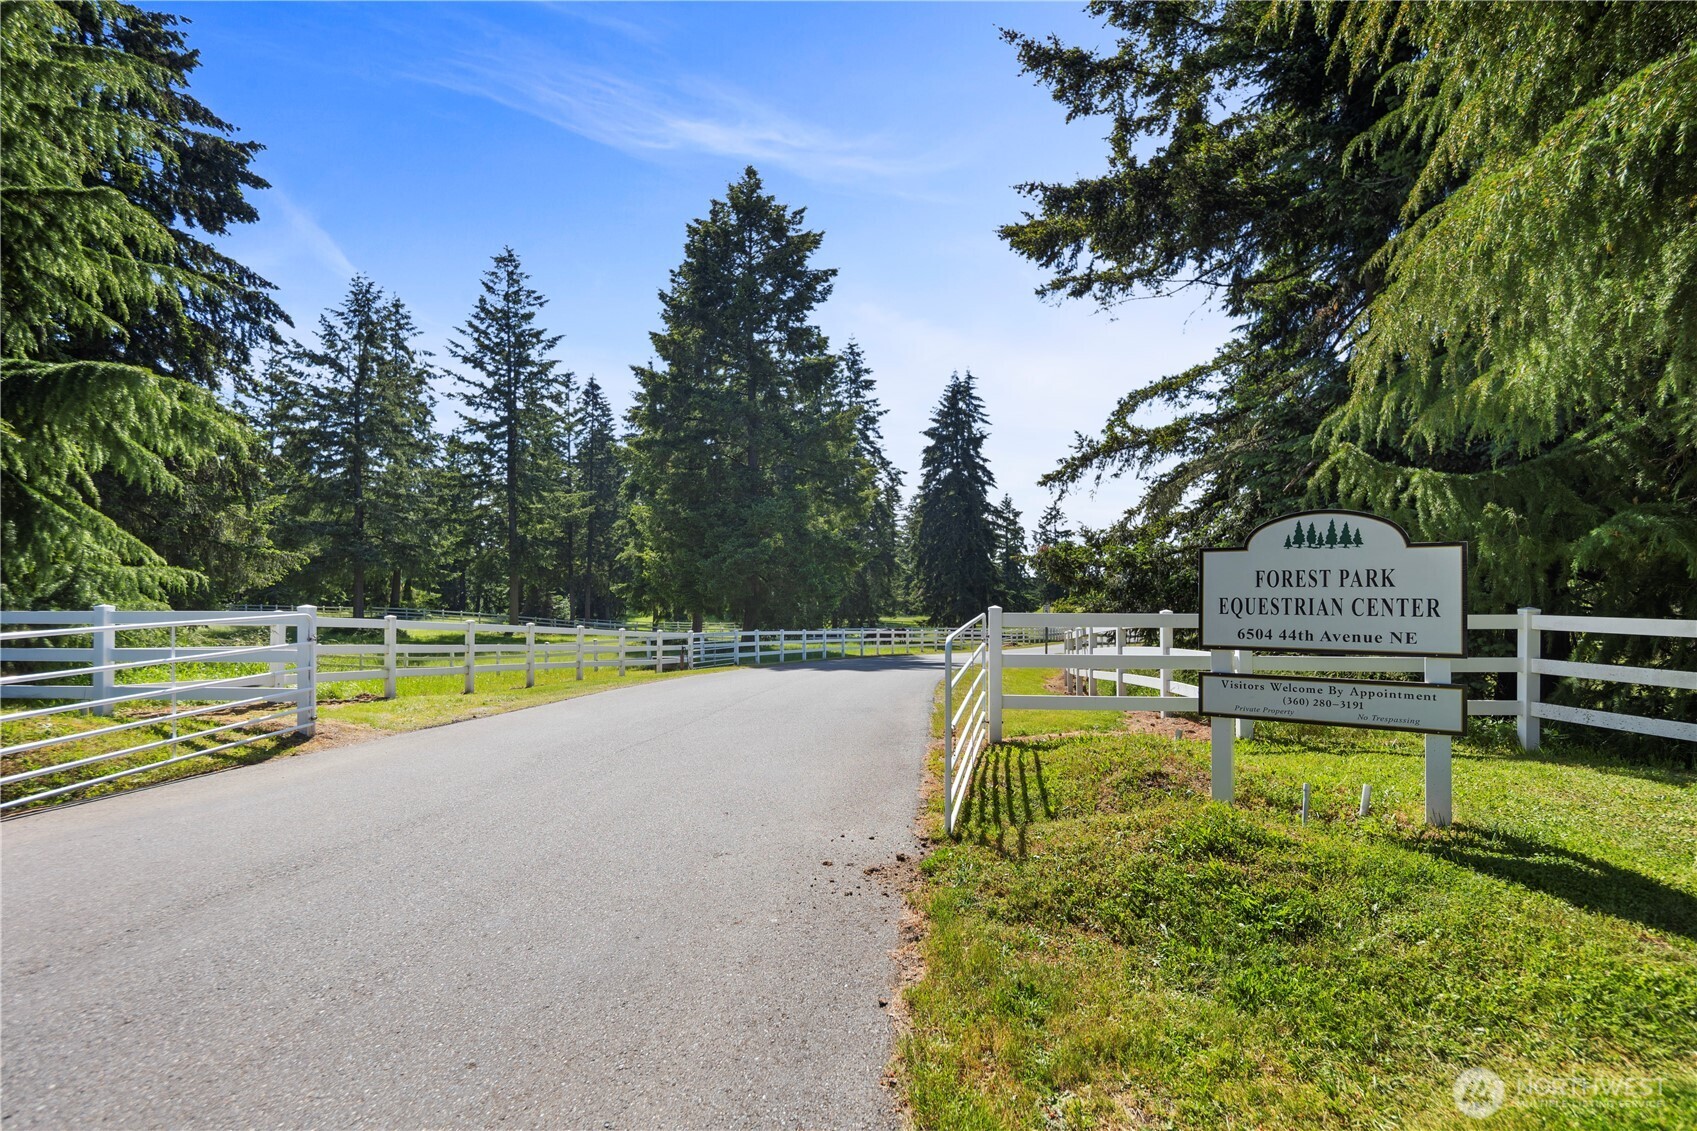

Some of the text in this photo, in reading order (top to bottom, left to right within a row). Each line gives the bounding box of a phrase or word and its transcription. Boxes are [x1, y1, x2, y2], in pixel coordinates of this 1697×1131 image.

[1255, 568, 1396, 588] FOREST PARK
[1219, 597, 1441, 619] EQUESTRIAN CENTER
[1237, 628, 1418, 645] 6504 44th Avenue NE
[1221, 679, 1437, 702] Visitors Welcome By Appointment
[1234, 704, 1295, 716] Private Property
[1282, 696, 1364, 710] (360) 280-3191
[1357, 713, 1421, 726] No Trespassing
